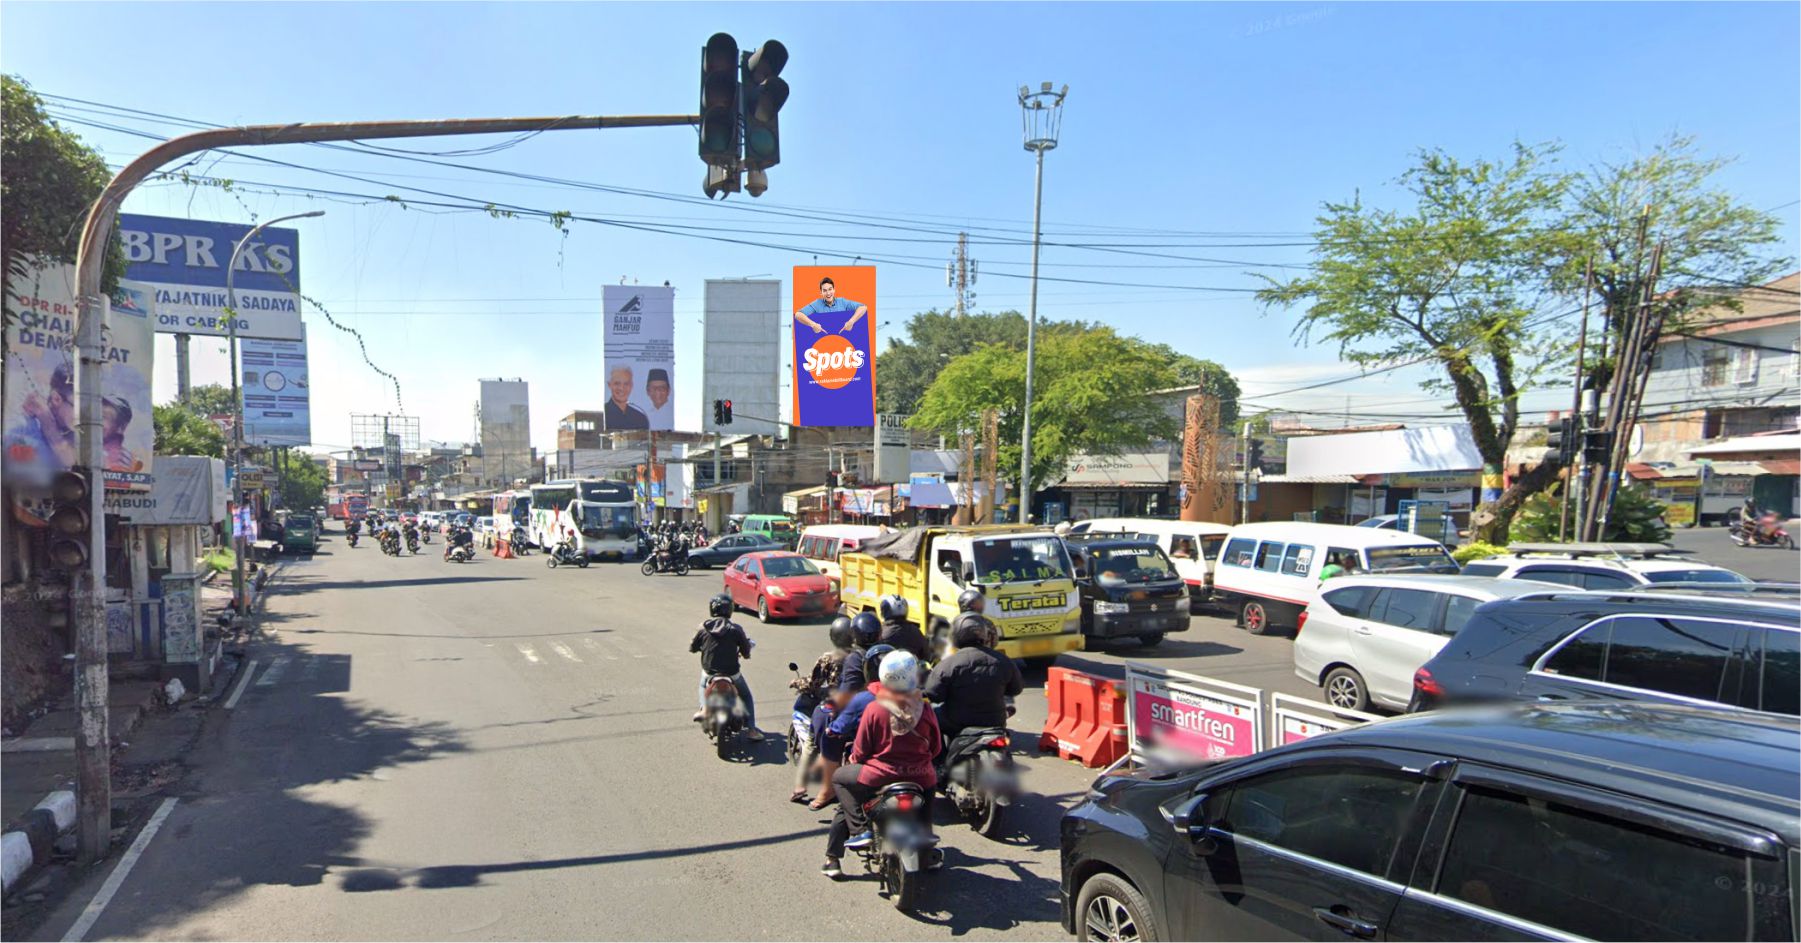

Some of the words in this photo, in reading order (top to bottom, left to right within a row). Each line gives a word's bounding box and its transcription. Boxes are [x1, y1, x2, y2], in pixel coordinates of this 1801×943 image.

[121, 229, 219, 268] BPR
[231, 240, 293, 274] KS
[19, 296, 49, 312] DPR
[242, 296, 296, 312] SADAYA
[155, 313, 180, 326] OR
[614, 316, 642, 324] GANJAR
[613, 324, 641, 332] MAHFUD
[803, 347, 866, 376] Spots
[880, 414, 911, 428] POLIS
[998, 593, 1067, 613] Teratai
[1151, 701, 1234, 742] smartfren
